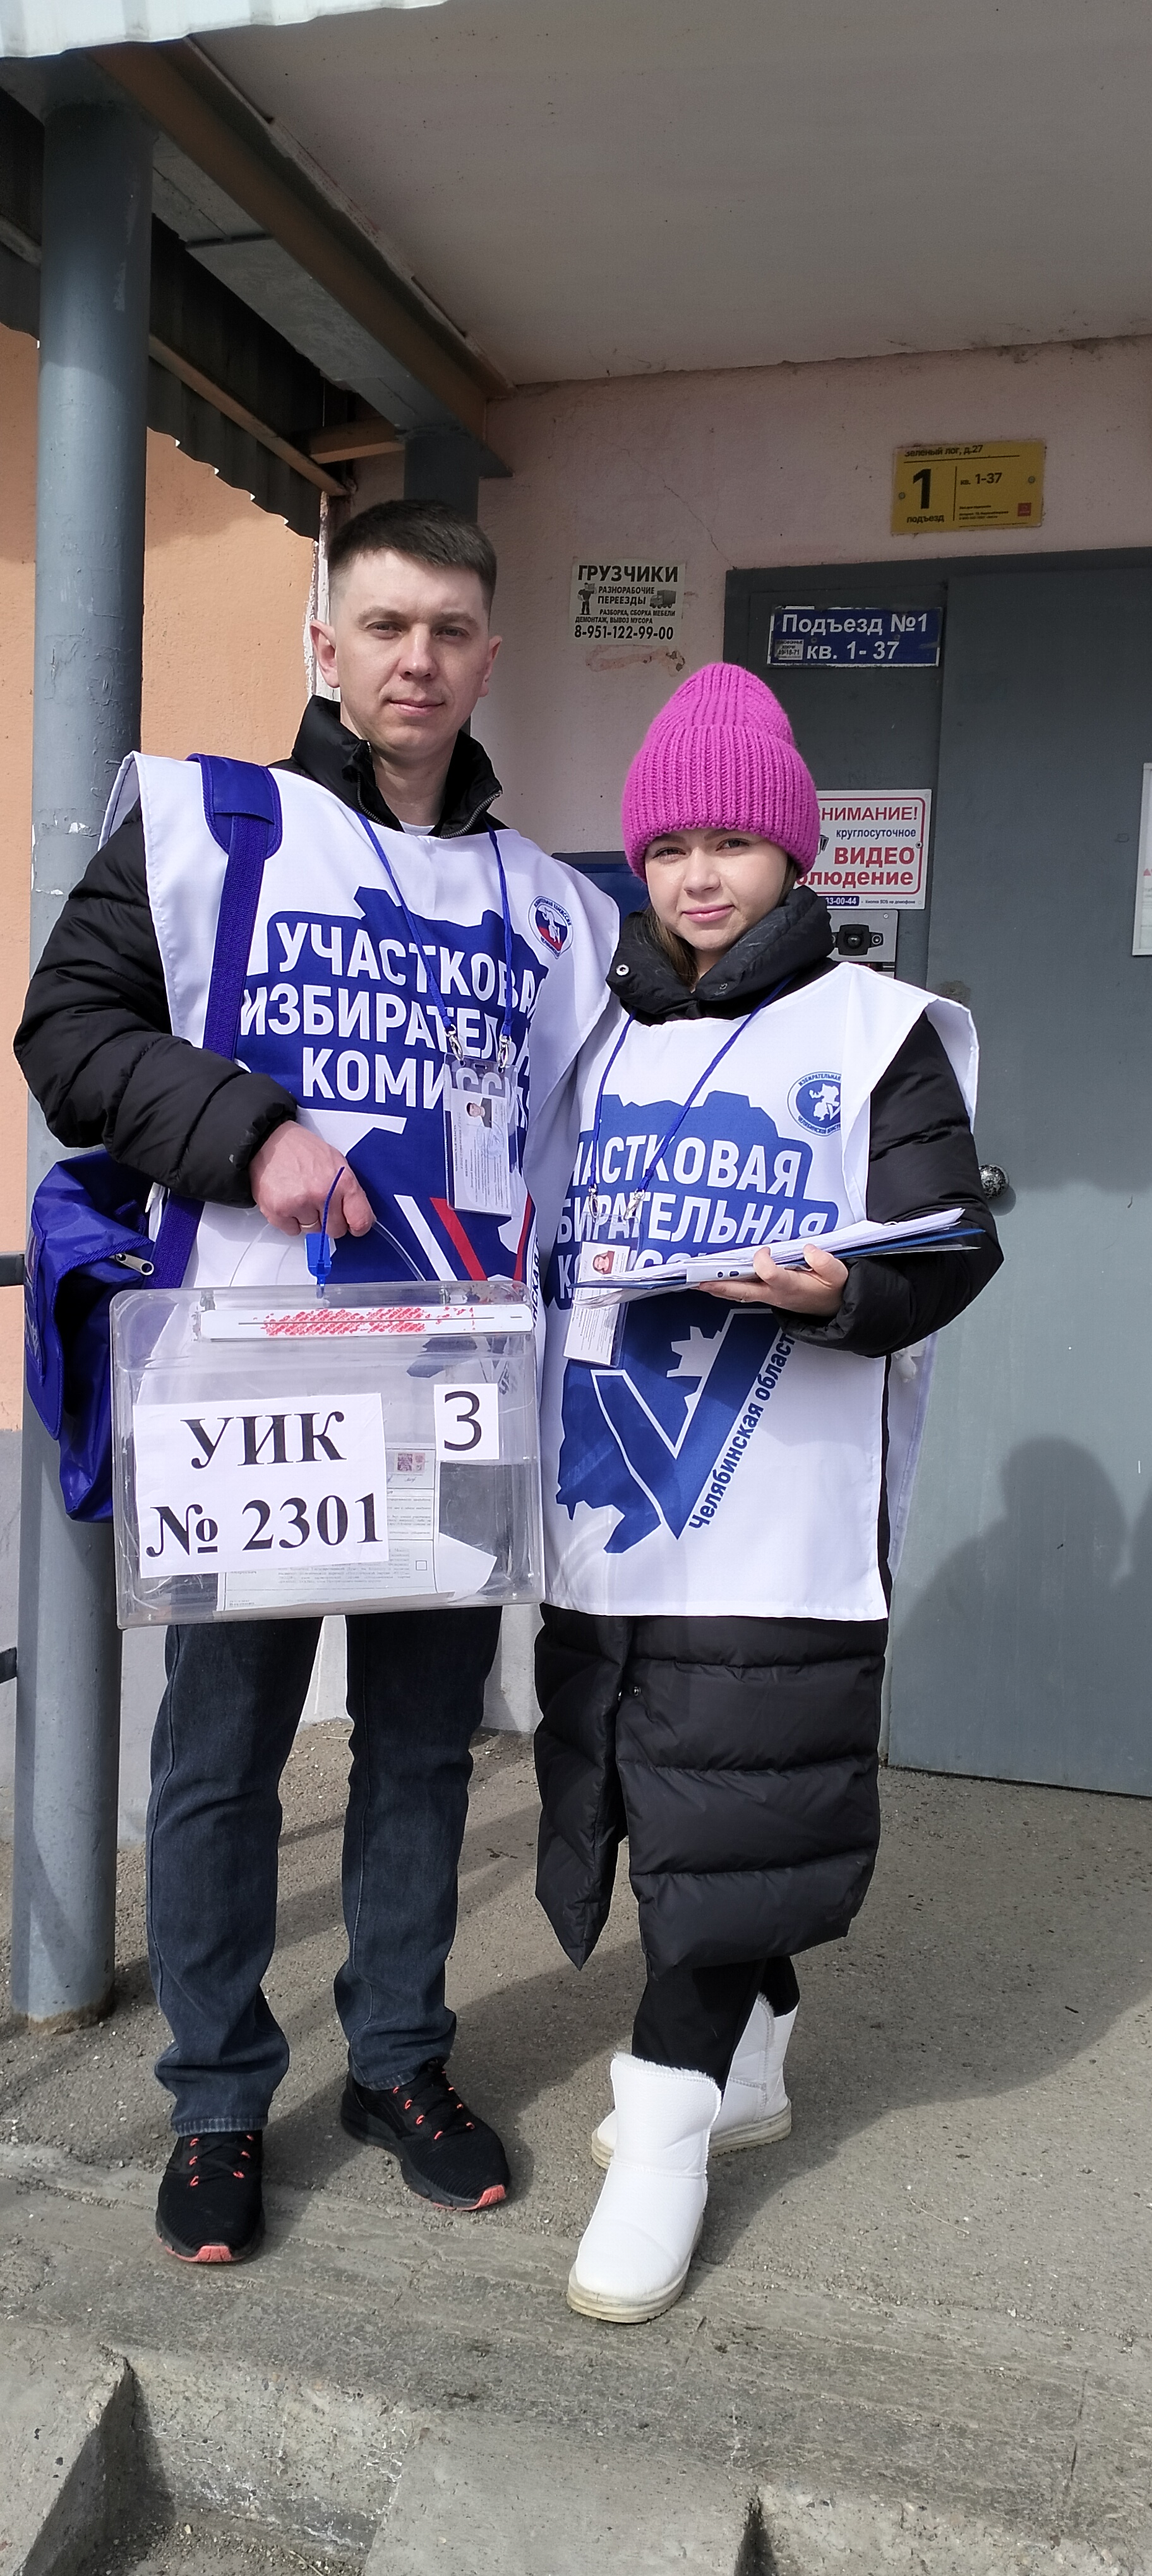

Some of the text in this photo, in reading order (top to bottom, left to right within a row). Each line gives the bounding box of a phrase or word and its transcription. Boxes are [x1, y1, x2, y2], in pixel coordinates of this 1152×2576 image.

[913, 468, 932, 509] 1
[975, 472, 1002, 484] 1-37
[907, 515, 944, 523] подъезд
[578, 565, 678, 582] ГРУЗЧИКИ
[597, 596, 645, 605] ПЕРЕЕЗДЫ
[575, 625, 673, 640] 8-951-122-99-00
[782, 613, 927, 635] Подъезд №1
[807, 645, 837, 659] кв.
[822, 807, 918, 821] НИМАНИЕ!
[836, 829, 916, 840] круглосуточное
[834, 847, 915, 868] ВИДЕО
[276, 922, 545, 1018] УЧАСТКОВА
[572, 1134, 802, 1197] АСТКОВАЯ
[556, 1191, 828, 1244] БИРАТЕЛЬНАЯ
[443, 1391, 483, 1452] 3
[688, 1333, 795, 1529] Челябинская област
[181, 1410, 347, 1469] УИК
[146, 1504, 219, 1558] №
[242, 1493, 383, 1552] 2301
